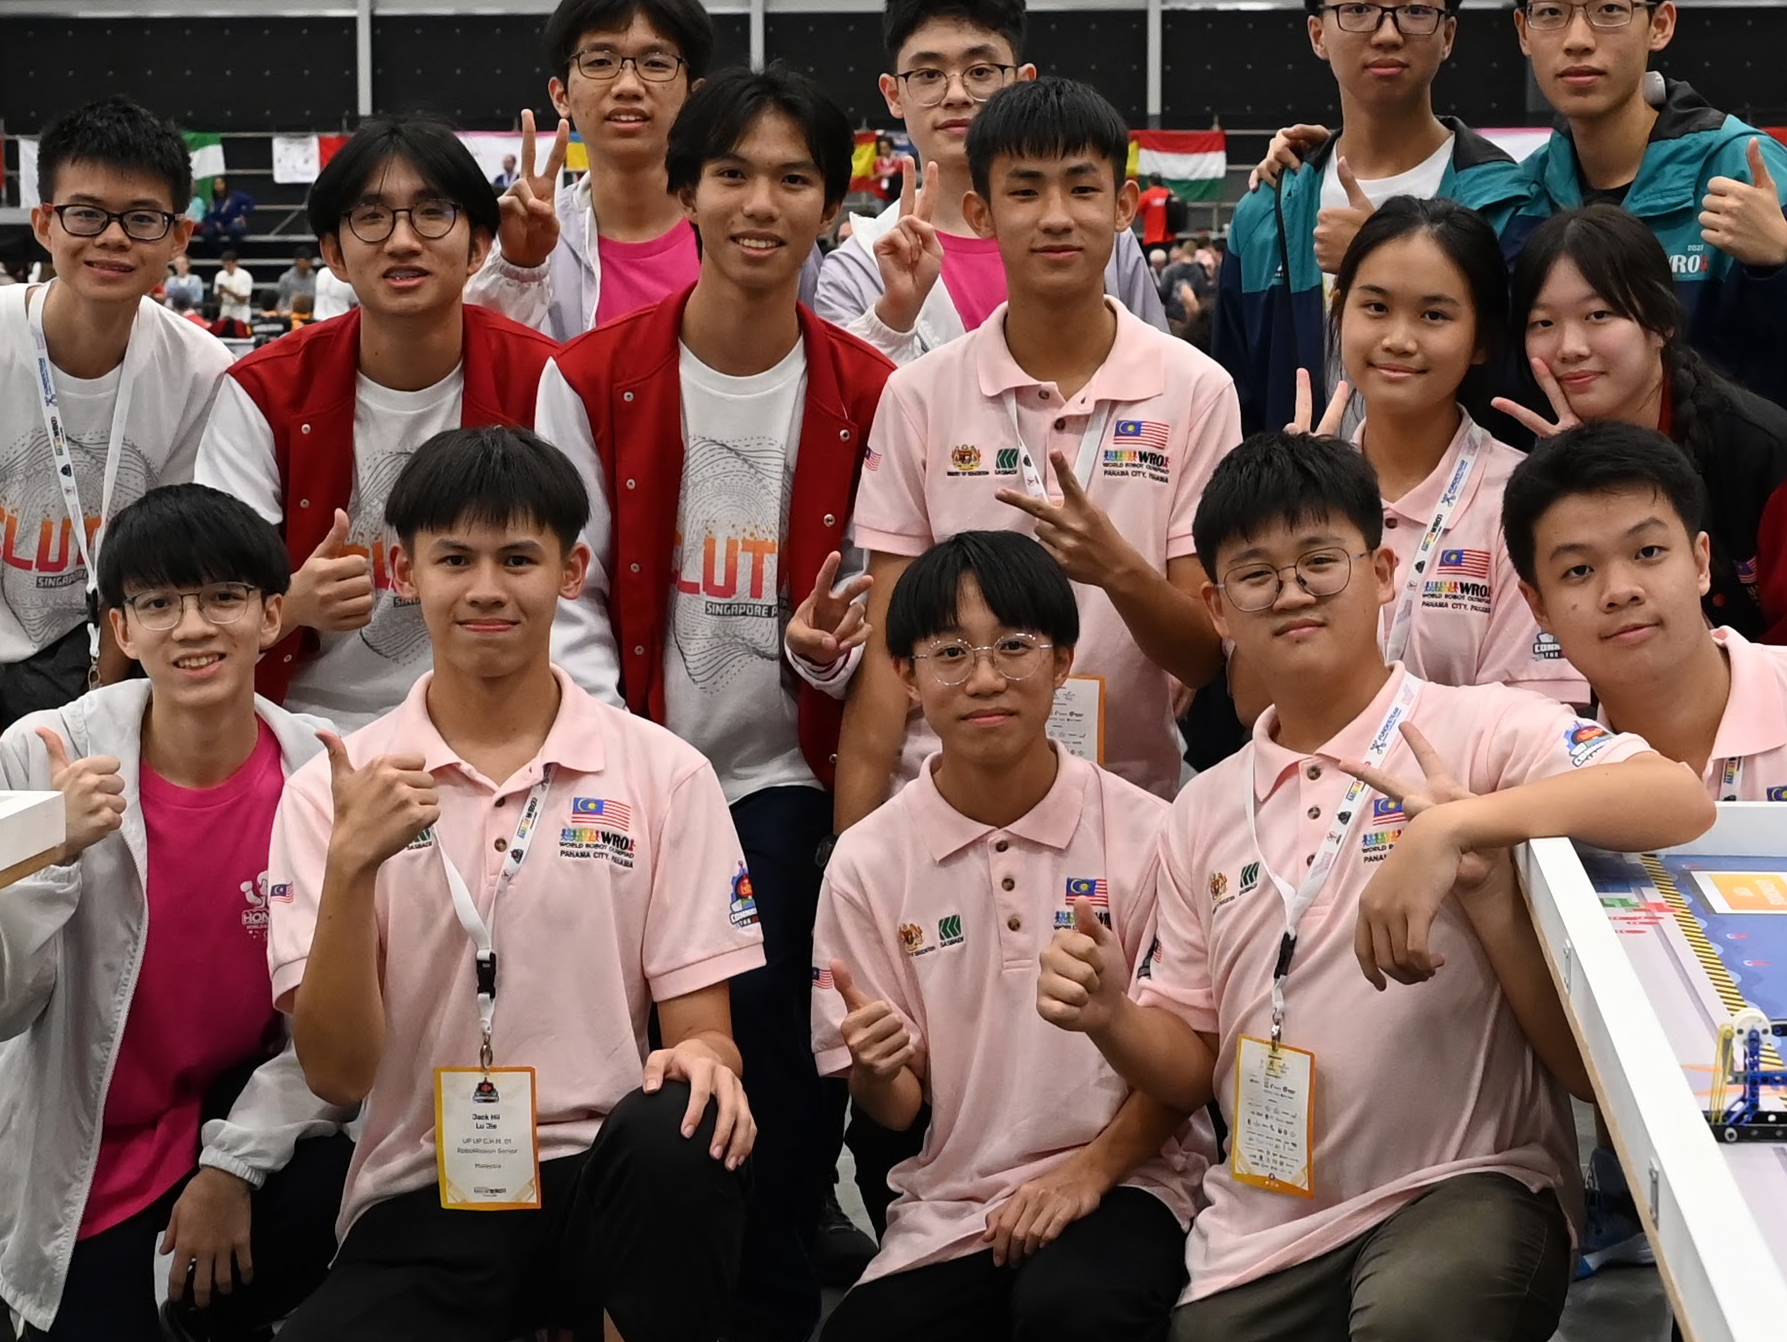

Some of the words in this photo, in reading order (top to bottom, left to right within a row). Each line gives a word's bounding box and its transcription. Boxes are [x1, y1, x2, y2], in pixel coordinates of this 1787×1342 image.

[1138, 450, 1165, 468] WRO
[1103, 469, 1130, 478] PANAMA
[1459, 581, 1488, 598] WRO
[705, 602, 769, 618] SINGAPORE
[601, 831, 630, 851] WRO
[560, 849, 591, 859] PANAMA
[472, 1113, 490, 1121] Jack
